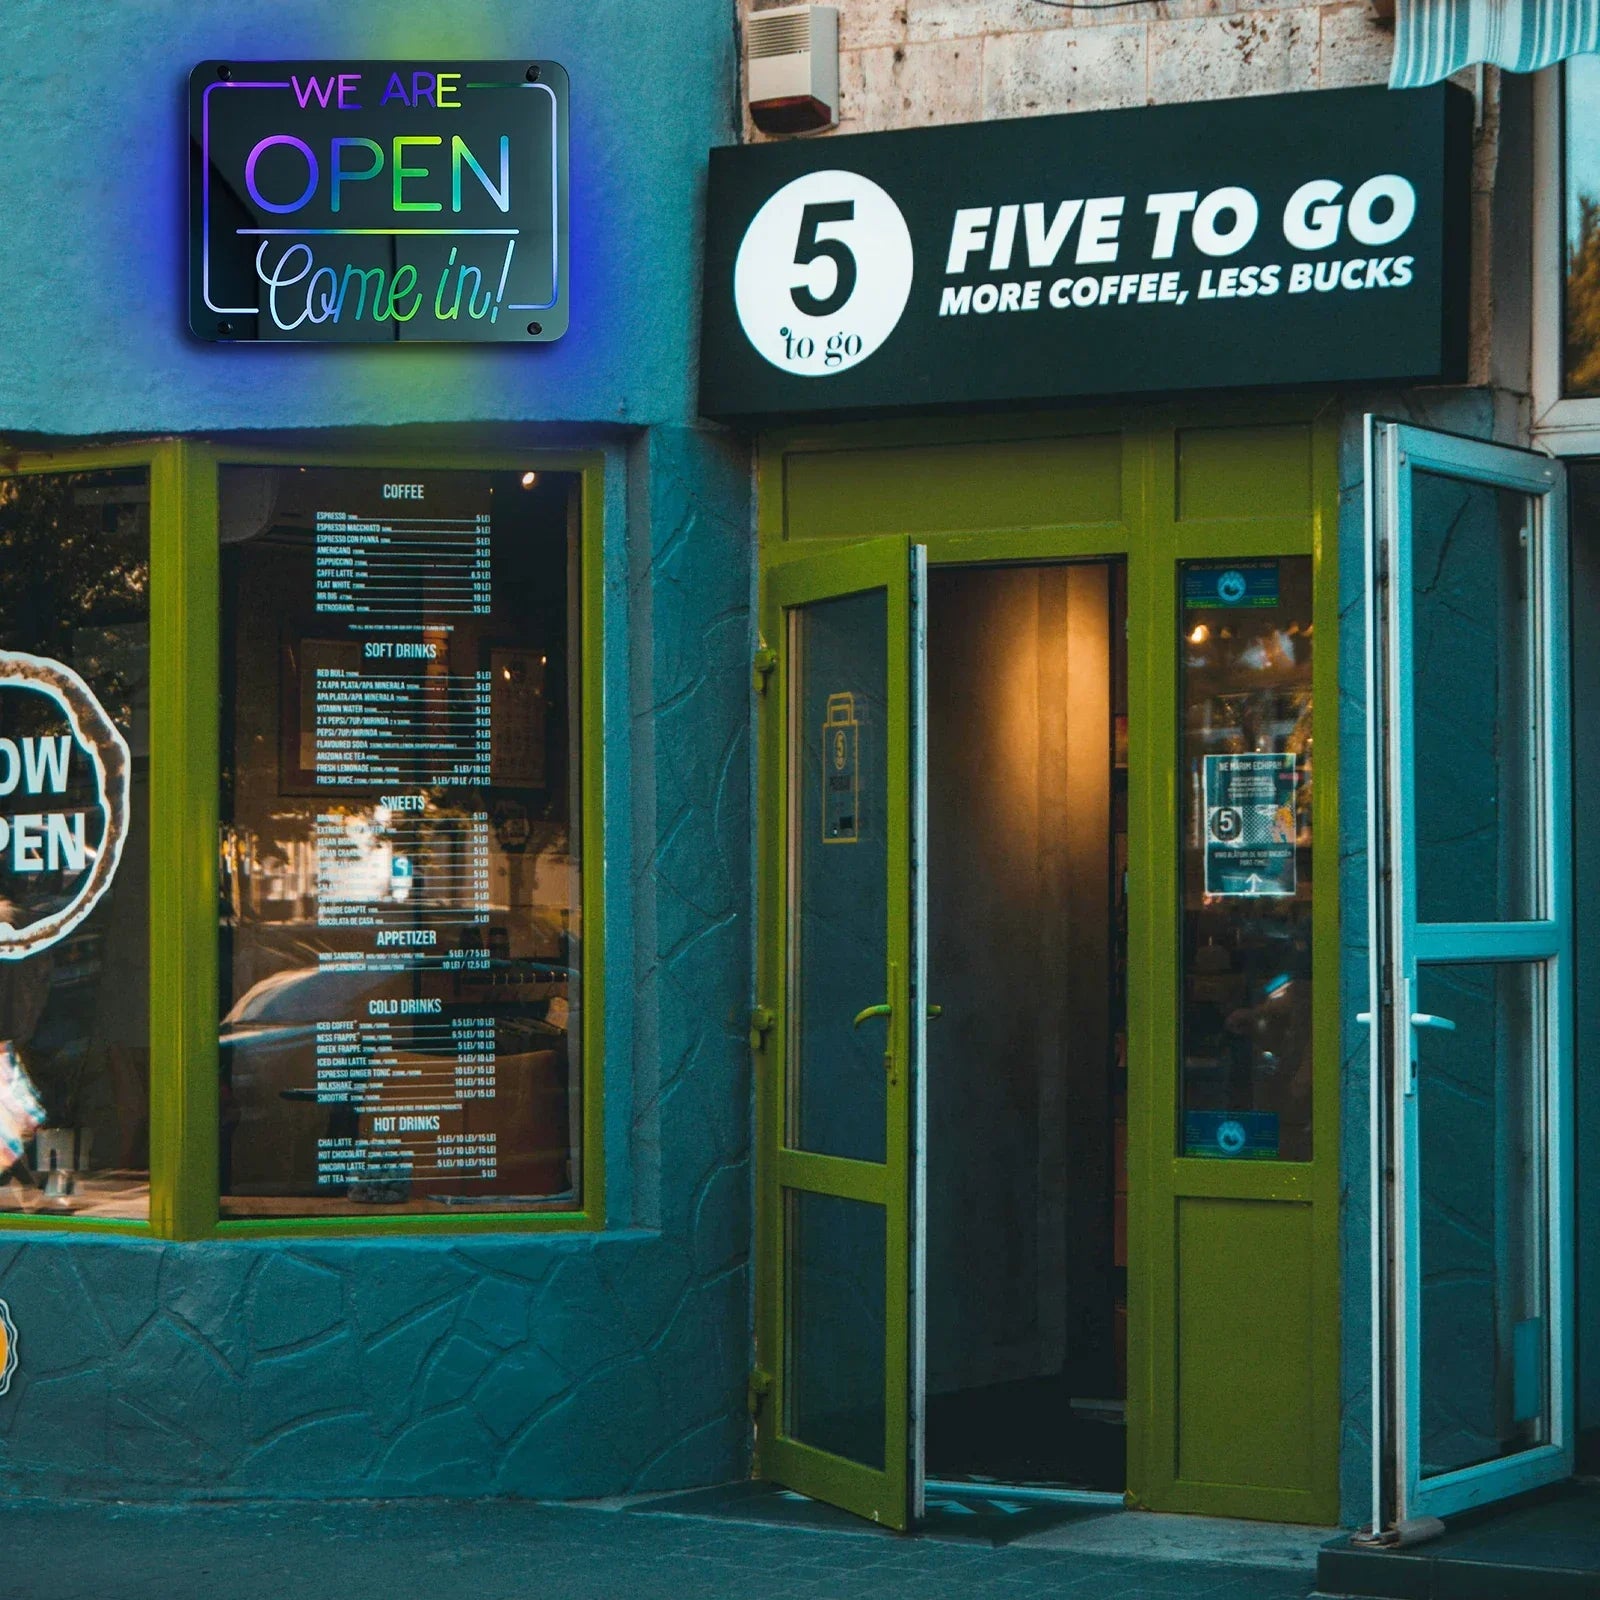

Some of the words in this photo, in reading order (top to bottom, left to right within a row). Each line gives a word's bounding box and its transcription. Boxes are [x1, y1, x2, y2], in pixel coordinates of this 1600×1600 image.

[291, 74, 362, 110] WE
[380, 71, 462, 108] ARE
[245, 134, 510, 214] OPEN
[945, 196, 1125, 275] FIVE
[1145, 185, 1259, 258] TO
[1282, 174, 1416, 251] GO
[789, 199, 858, 317] 5
[255, 240, 423, 331] Come
[434, 239, 516, 324] in!
[938, 281, 1041, 316] MORE
[1048, 271, 1188, 307] COFFEE,
[1197, 264, 1281, 300] LESS
[1287, 255, 1415, 294] BUCKS
[824, 331, 862, 367] go
[383, 484, 424, 499] COFFEE
[317, 512, 346, 520] ESPRESSO
[482, 594, 490, 602] LEI
[365, 643, 394, 657] SOFT
[396, 644, 436, 658] DRINKS
[317, 669, 330, 677] RED
[482, 742, 491, 750] LEI
[317, 764, 337, 772] FRESH
[338, 764, 369, 772] LEMONADE
[317, 776, 336, 784] FRESH
[337, 776, 353, 784] JUICE
[380, 796, 425, 810] SWEETS
[1219, 811, 1233, 831] 5
[377, 931, 436, 945] APPETIZER
[369, 1000, 398, 1015] COLD
[400, 999, 441, 1014] DRINKS
[317, 1022, 330, 1030] ICED
[317, 1058, 331, 1066] ICED
[347, 1057, 366, 1065] LATTE
[373, 1069, 390, 1077] TONIC
[317, 1082, 352, 1090] MILKSHAKE
[374, 1117, 396, 1131] HOT
[400, 1116, 440, 1130] DRINKS
[332, 1150, 366, 1158] CHOCOLATE
[318, 1176, 331, 1184] HOT
